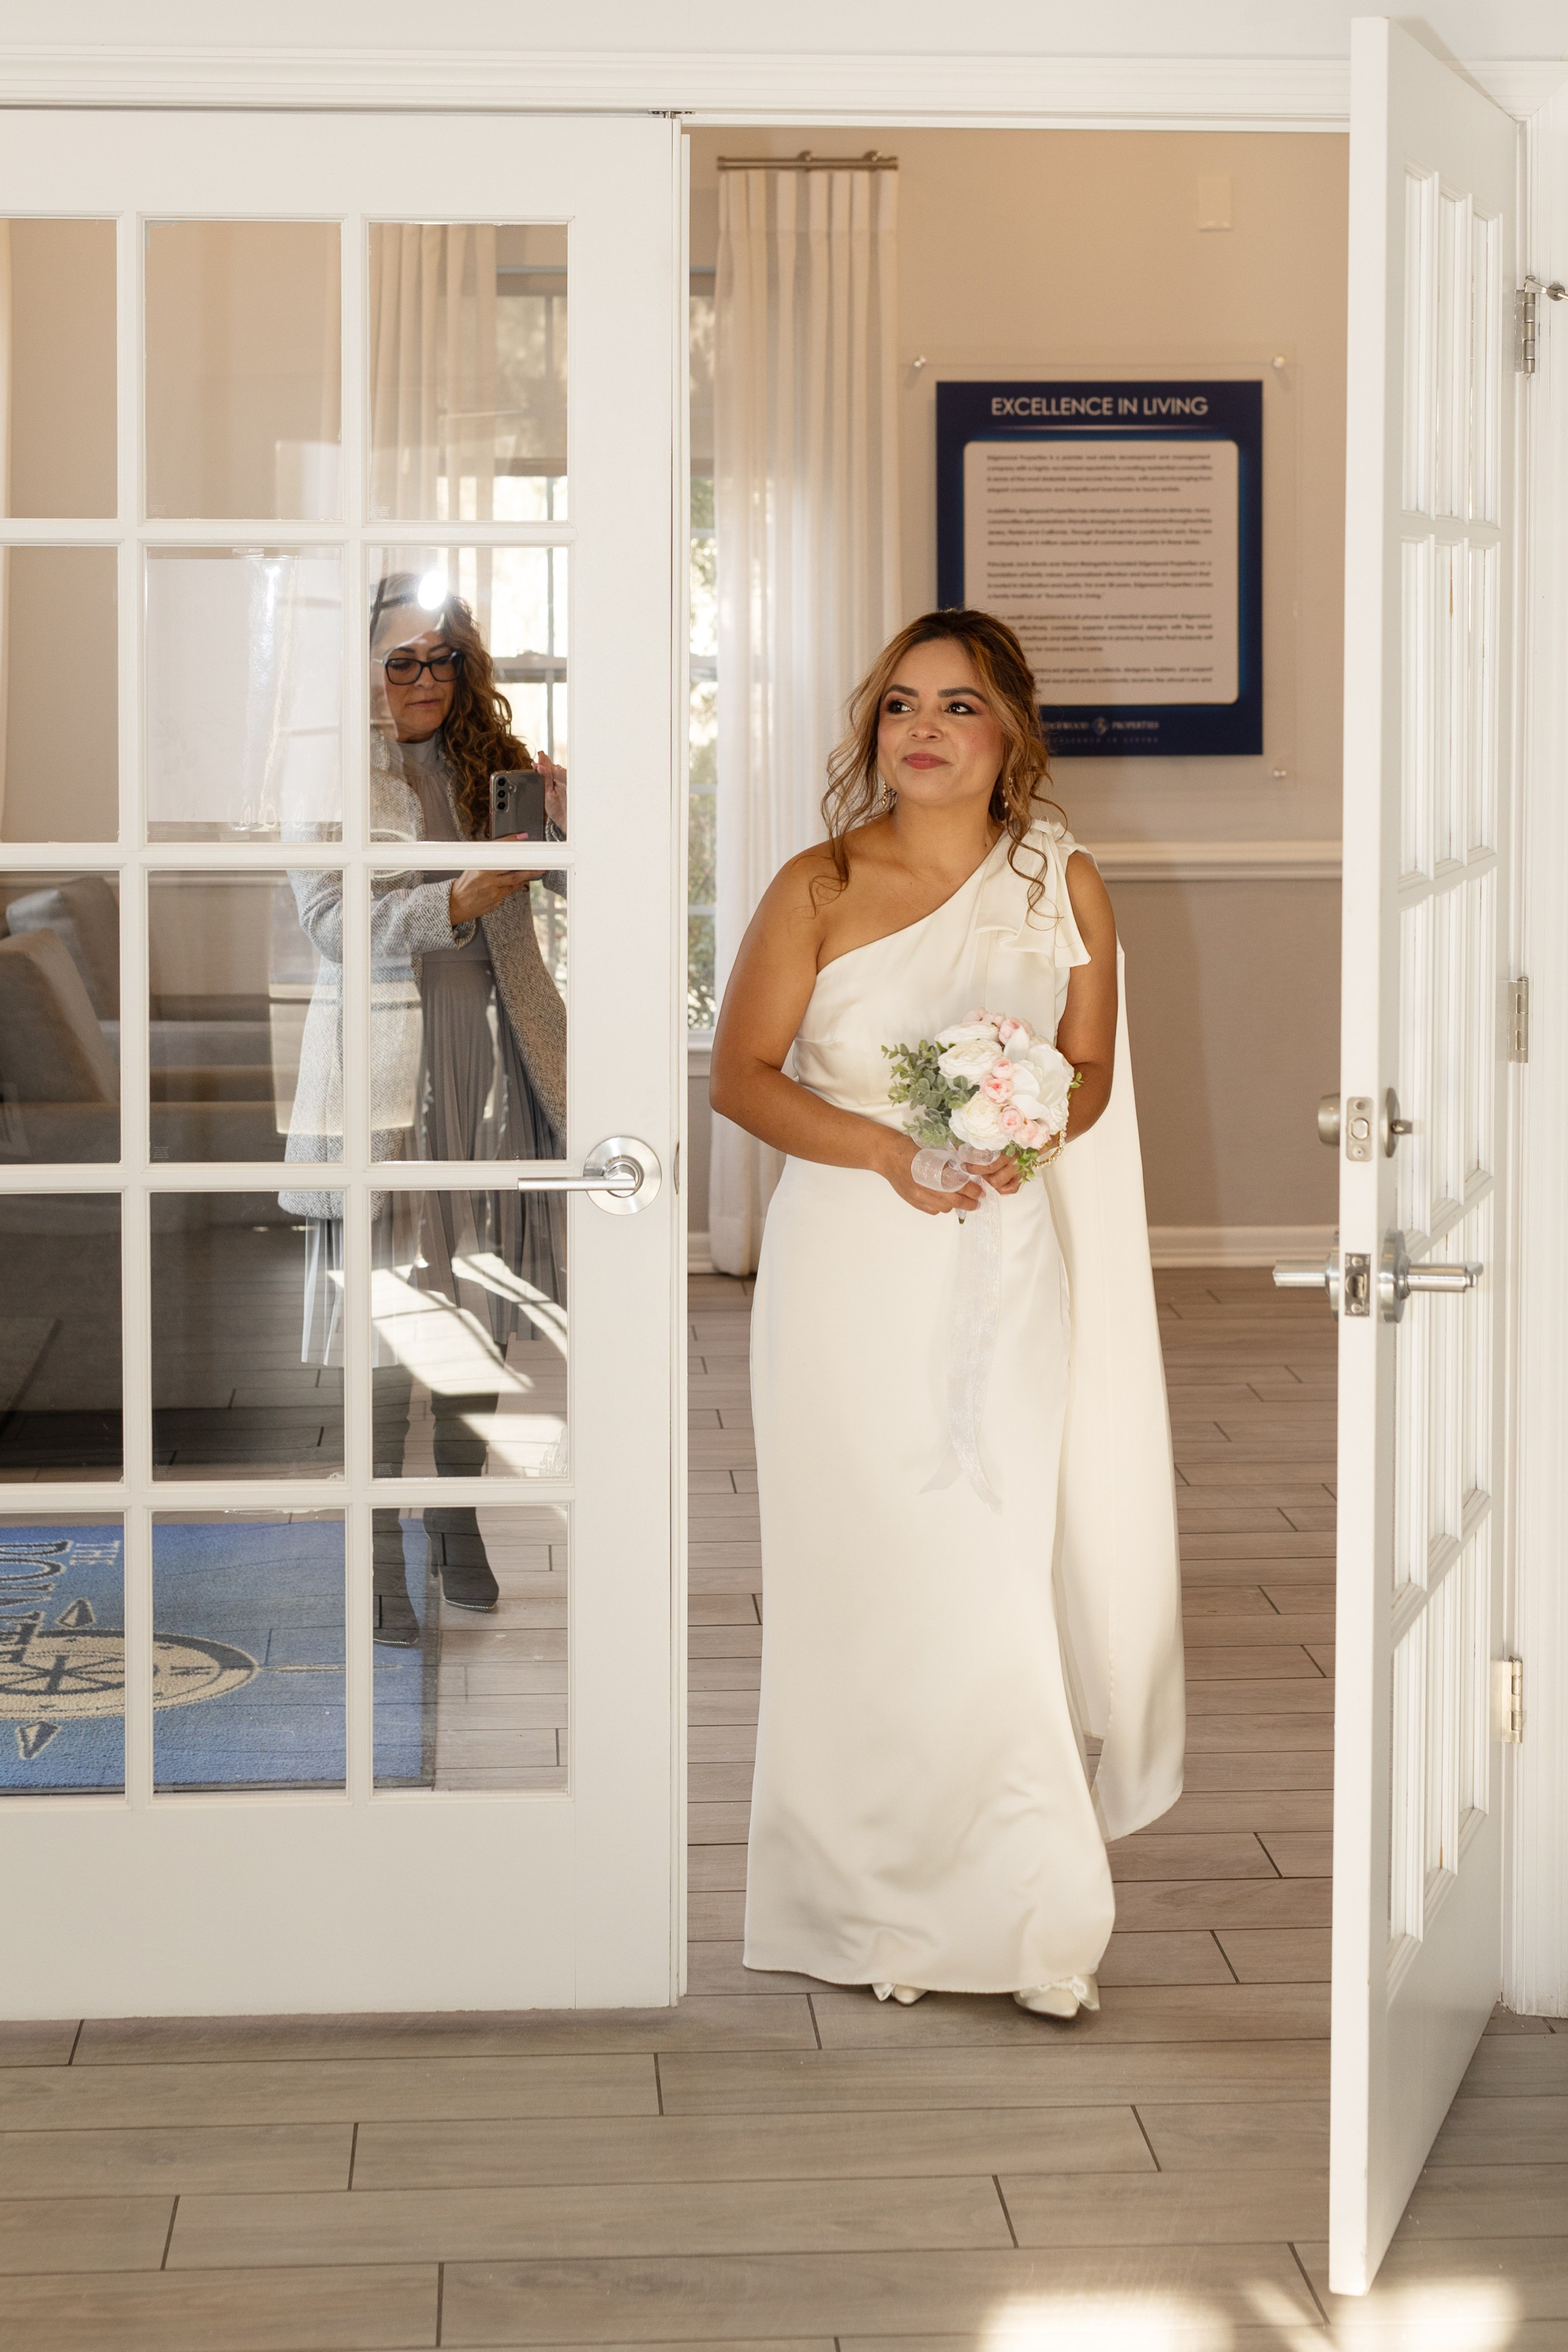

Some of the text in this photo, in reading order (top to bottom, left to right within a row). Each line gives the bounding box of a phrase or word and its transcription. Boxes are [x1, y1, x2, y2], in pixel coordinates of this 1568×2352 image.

[991, 396, 1208, 417] EXCELLENCE IN LIVING
[69, 1540, 121, 1566] THE
